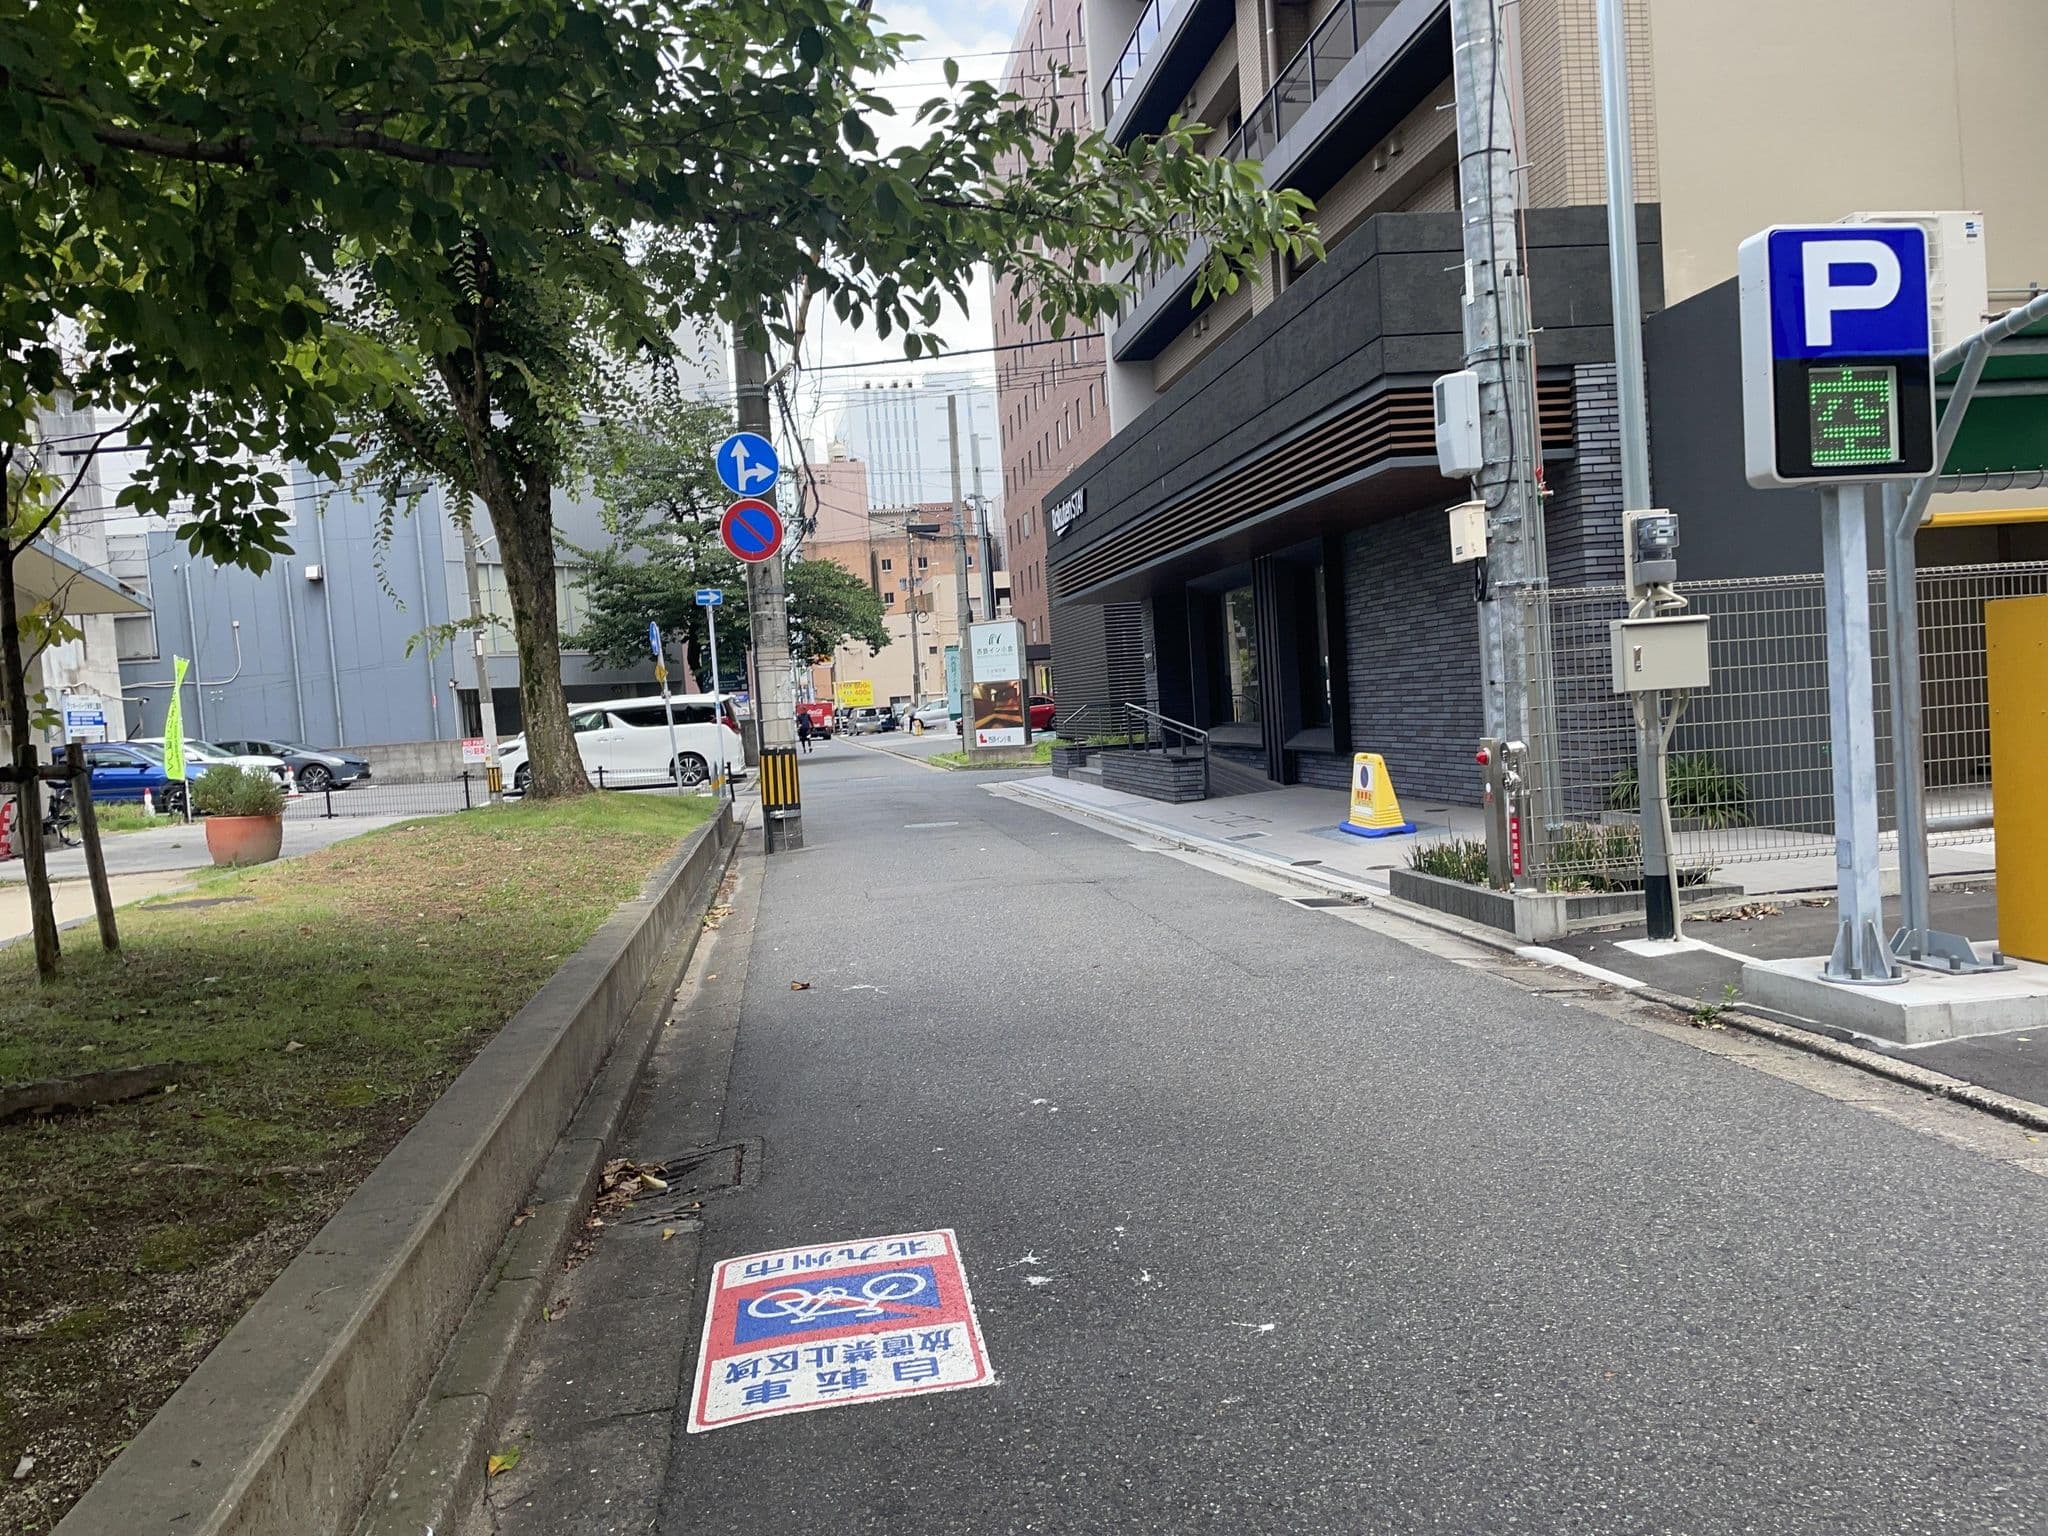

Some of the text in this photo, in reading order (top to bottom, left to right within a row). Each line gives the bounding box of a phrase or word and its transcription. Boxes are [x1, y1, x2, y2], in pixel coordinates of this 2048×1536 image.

[1801, 240, 1902, 347] P
[1810, 369, 1892, 462] 空
[743, 1240, 927, 1277] 北九州市
[724, 1329, 954, 1385] 放置禁止区域
[740, 1356, 940, 1407] 自転車
